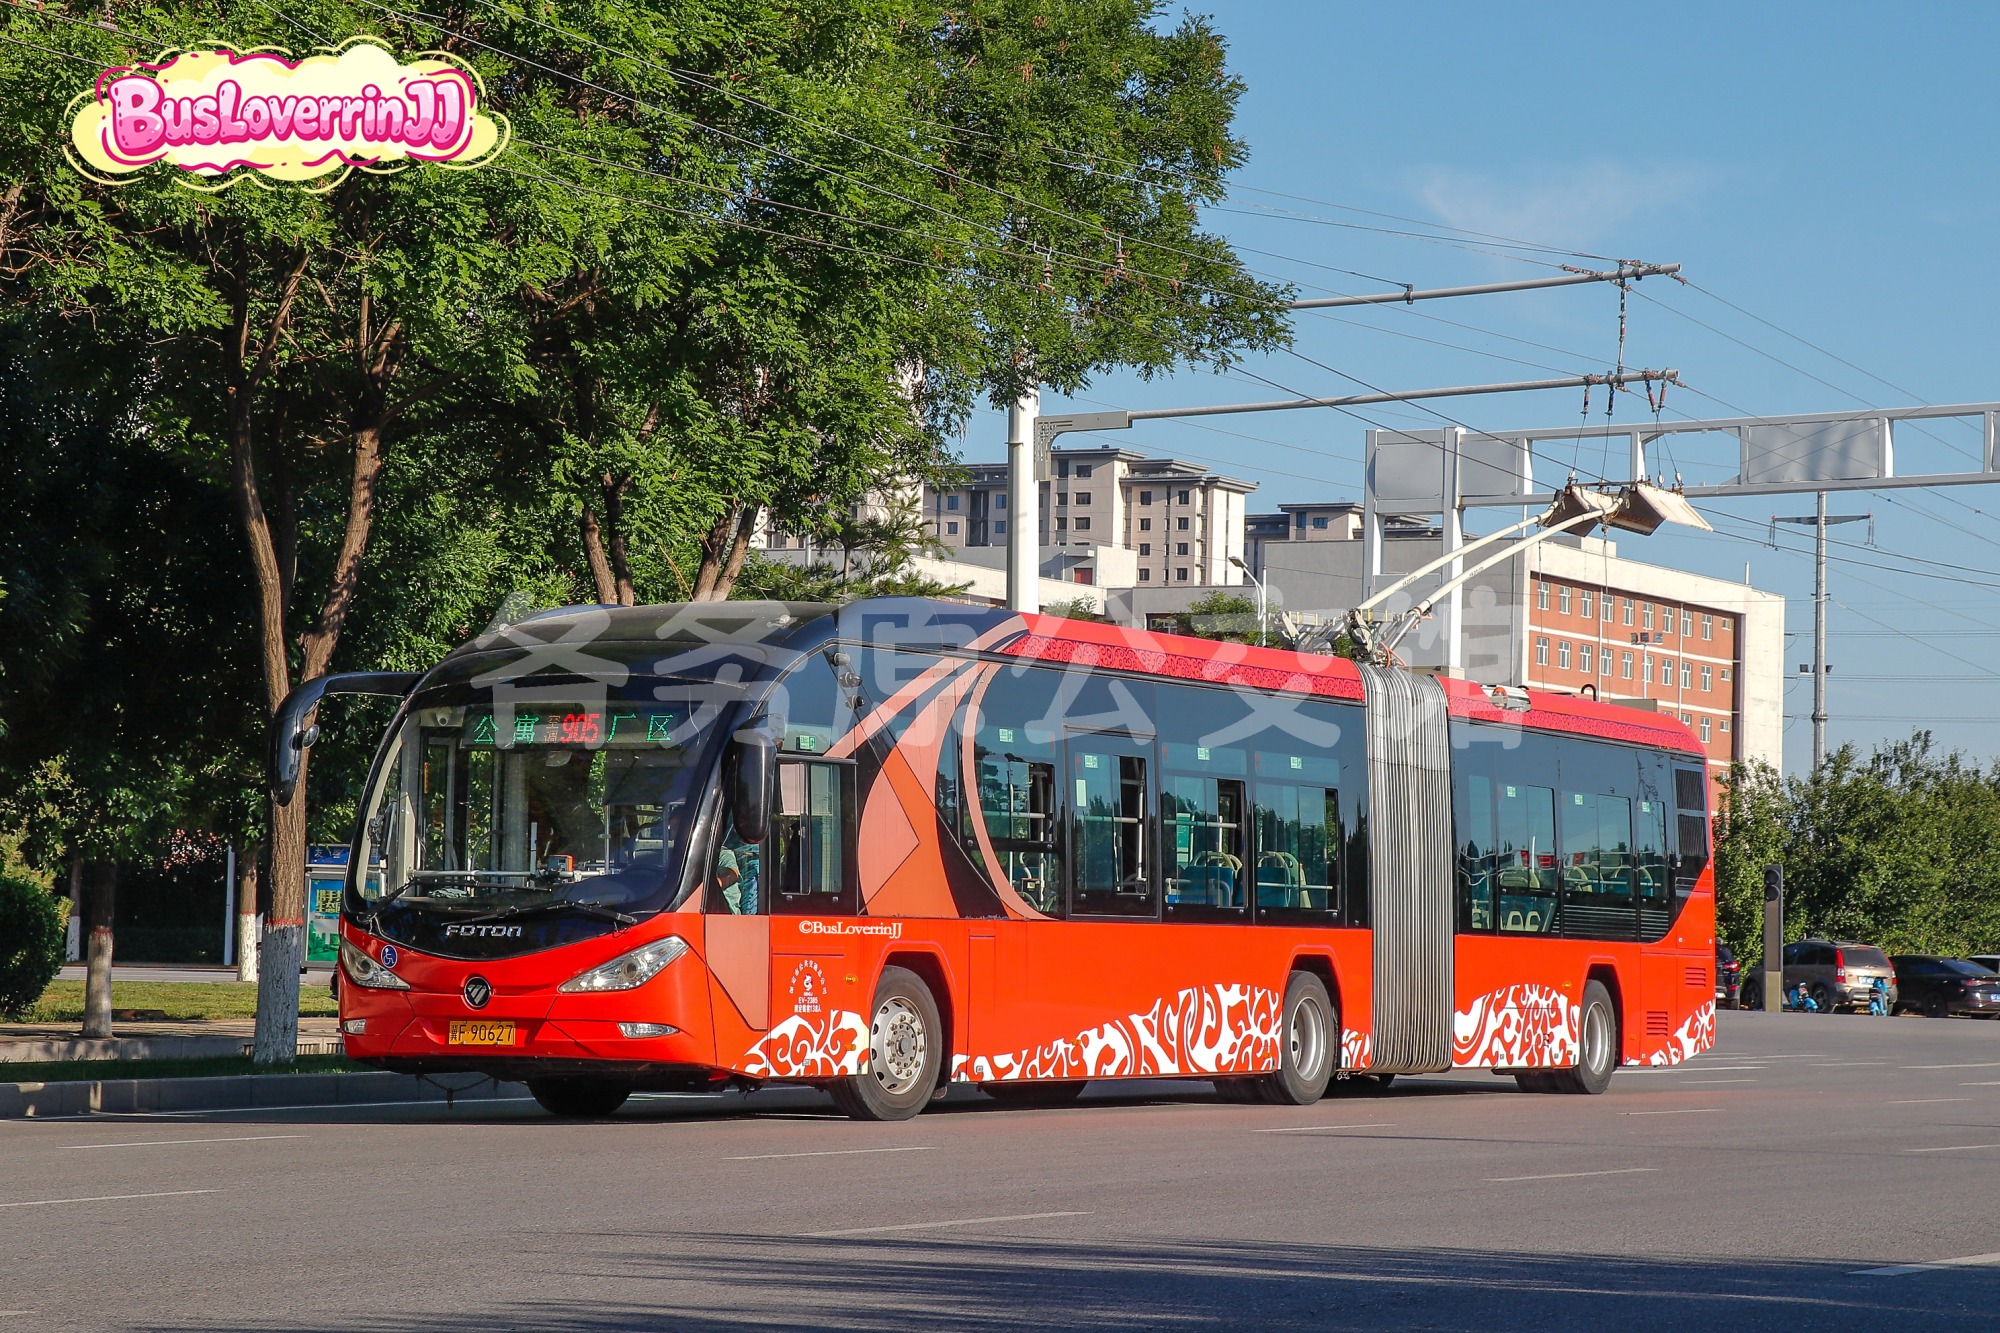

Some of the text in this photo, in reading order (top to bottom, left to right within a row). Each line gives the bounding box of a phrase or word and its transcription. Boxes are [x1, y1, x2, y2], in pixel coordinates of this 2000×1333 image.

[474, 713, 674, 744] 公寓 905 厂区
[446, 925, 522, 937] FOTON
